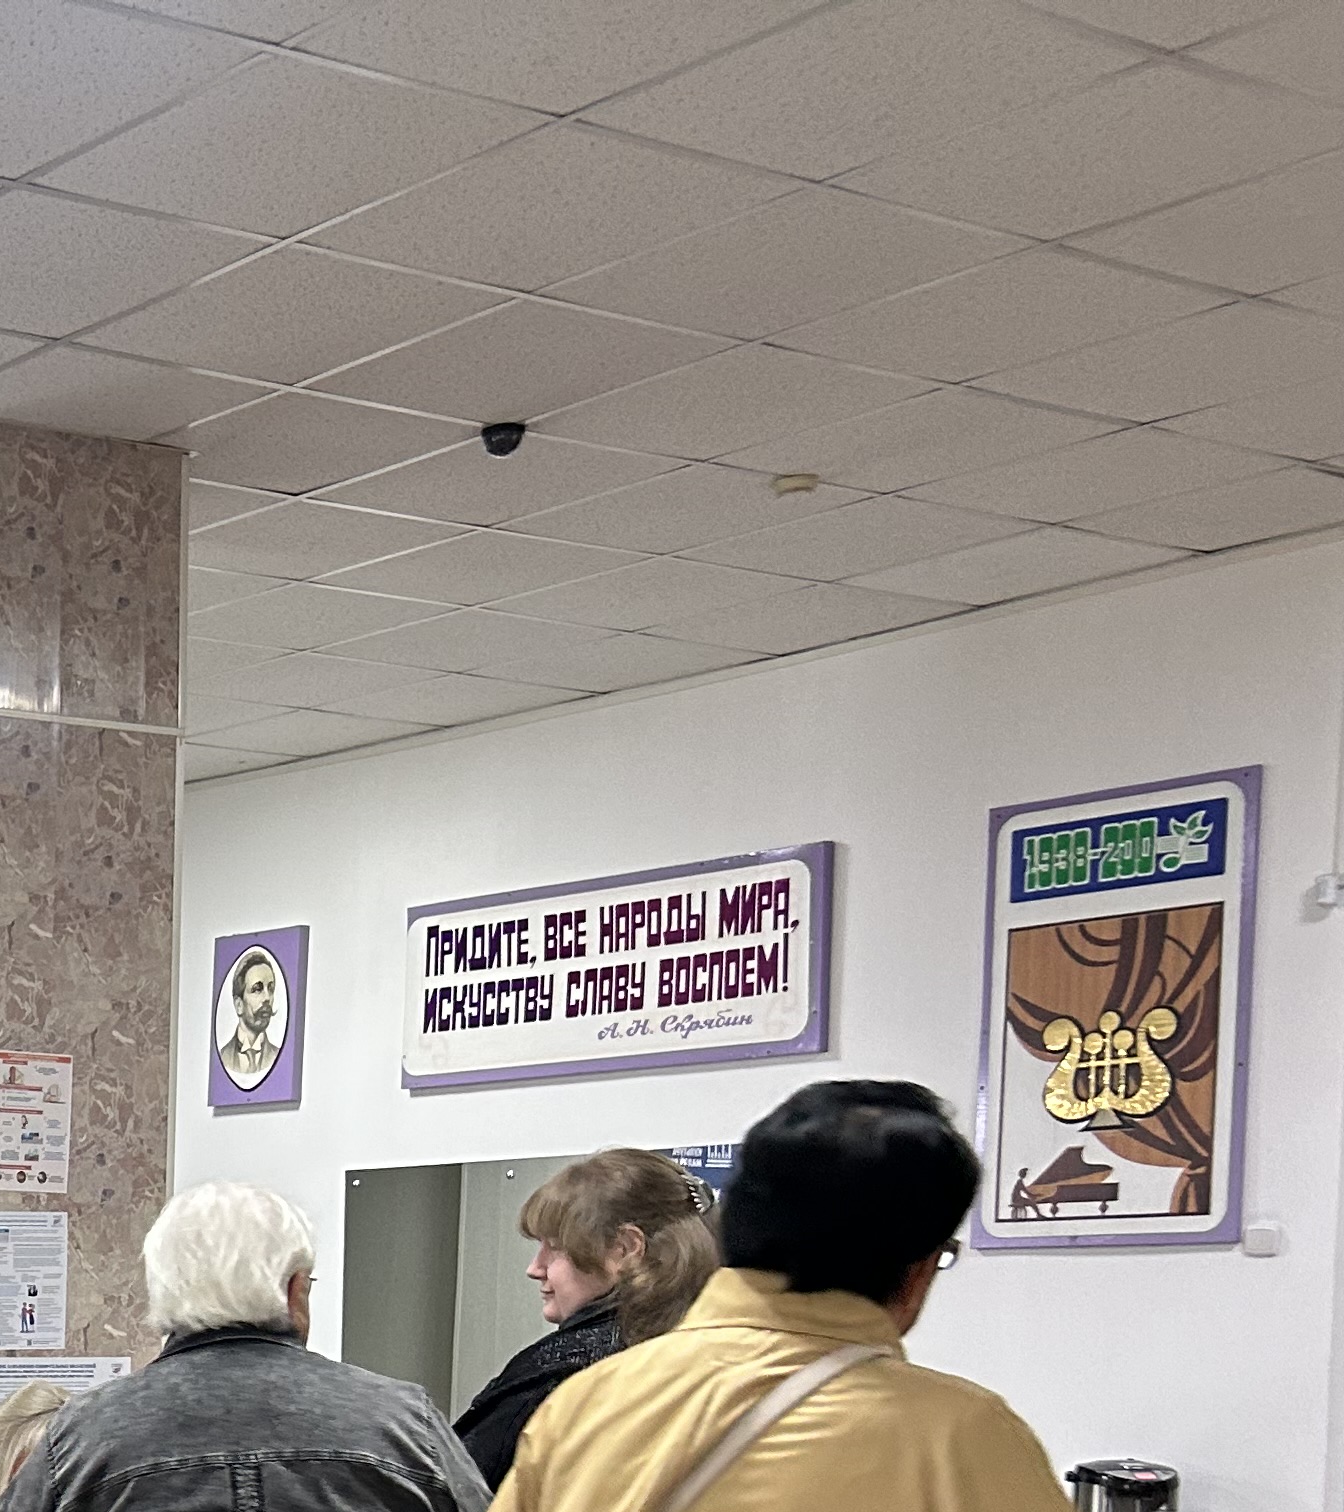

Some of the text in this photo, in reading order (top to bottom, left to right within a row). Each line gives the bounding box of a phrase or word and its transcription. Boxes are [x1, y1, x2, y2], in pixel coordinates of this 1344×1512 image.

[544, 909, 587, 962] ВСЕ
[599, 891, 707, 955] НАРОДЫ
[718, 877, 800, 938] МИРА,
[423, 932, 790, 1034] ИСКУССТВУ СЛАВУ ВОСПОЕМ!
[659, 1009, 754, 1040] Скрябин
